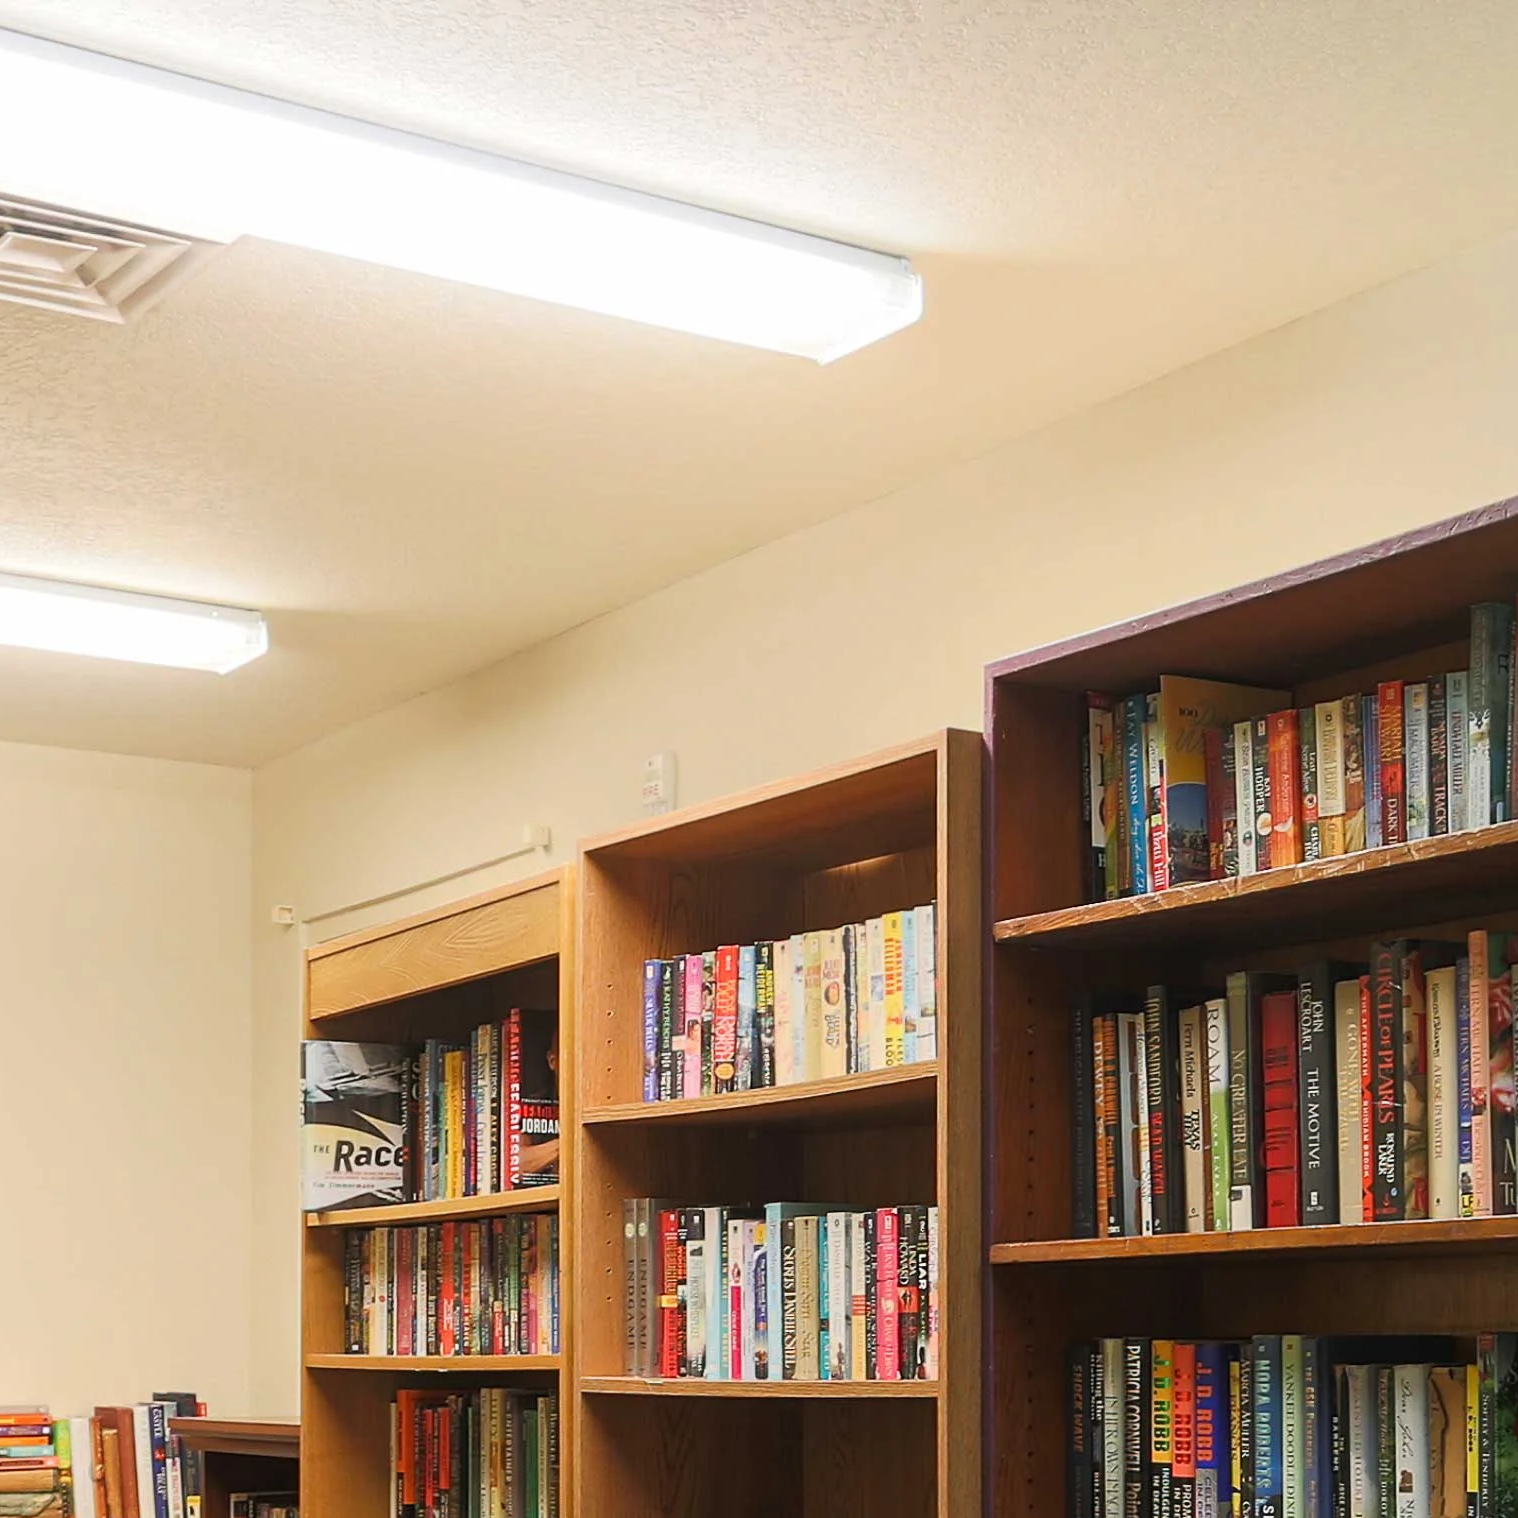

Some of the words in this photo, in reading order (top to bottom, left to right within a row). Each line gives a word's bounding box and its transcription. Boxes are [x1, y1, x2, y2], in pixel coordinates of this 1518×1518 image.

[1207, 1006, 1220, 1084] ROAM
[1307, 1068, 1319, 1097] THE
[313, 1143, 331, 1154] THE
[1307, 1101, 1320, 1170] MOTIVE
[334, 1139, 405, 1173] Race
